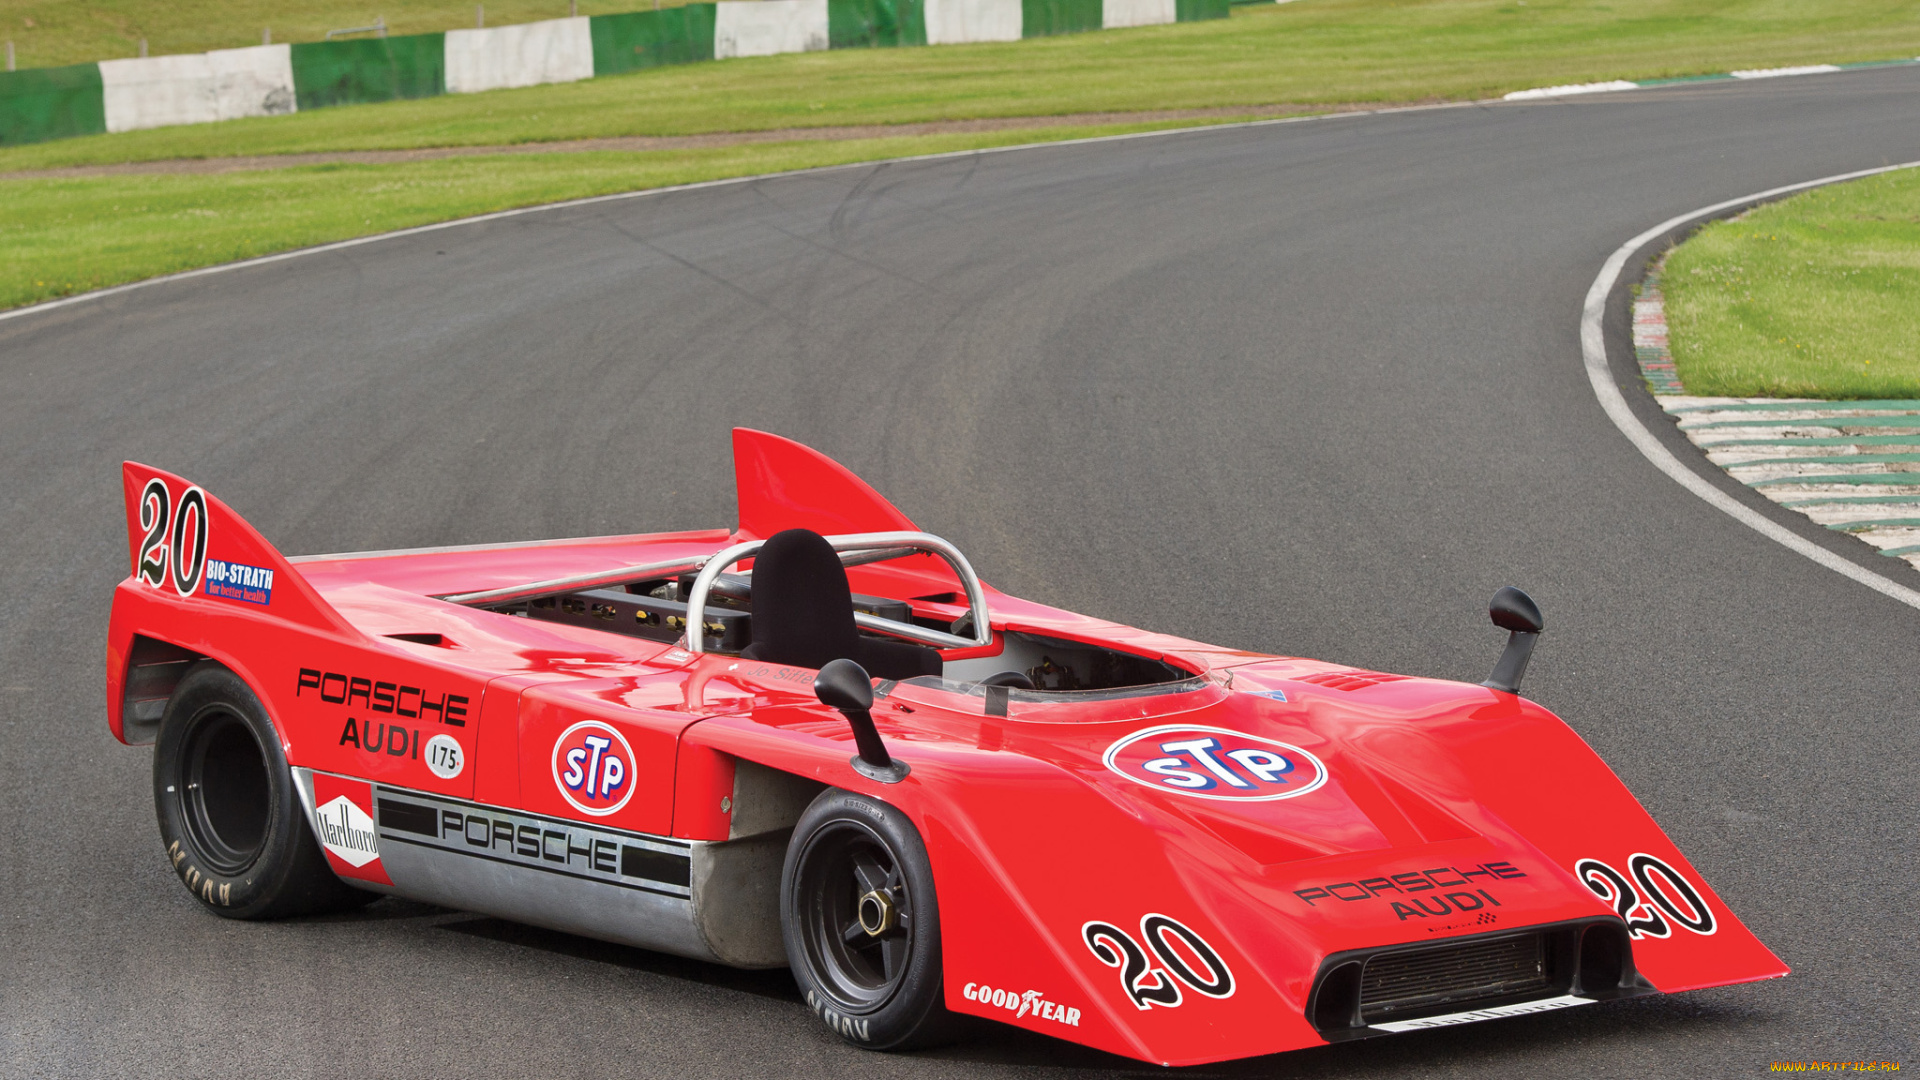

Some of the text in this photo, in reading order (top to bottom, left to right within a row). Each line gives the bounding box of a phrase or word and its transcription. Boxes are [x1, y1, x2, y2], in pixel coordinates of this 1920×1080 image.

[139, 477, 209, 597] 20
[206, 559, 274, 590] BIO-STRATH
[209, 581, 267, 603] for better health
[747, 664, 769, 677] Jo
[297, 668, 469, 727] PORSCHE
[339, 717, 419, 760] AUDI
[432, 744, 457, 770] 175
[563, 735, 625, 800] STP
[1141, 737, 1295, 790] STP
[317, 803, 377, 854] Marlboro
[442, 810, 617, 874] PORSCHE
[1293, 862, 1527, 906] PORSCHE
[1390, 889, 1502, 920] AUDI
[1575, 852, 1717, 940] 20
[1082, 912, 1236, 1011] 20
[1407, 1002, 1570, 1027] Marlboro
